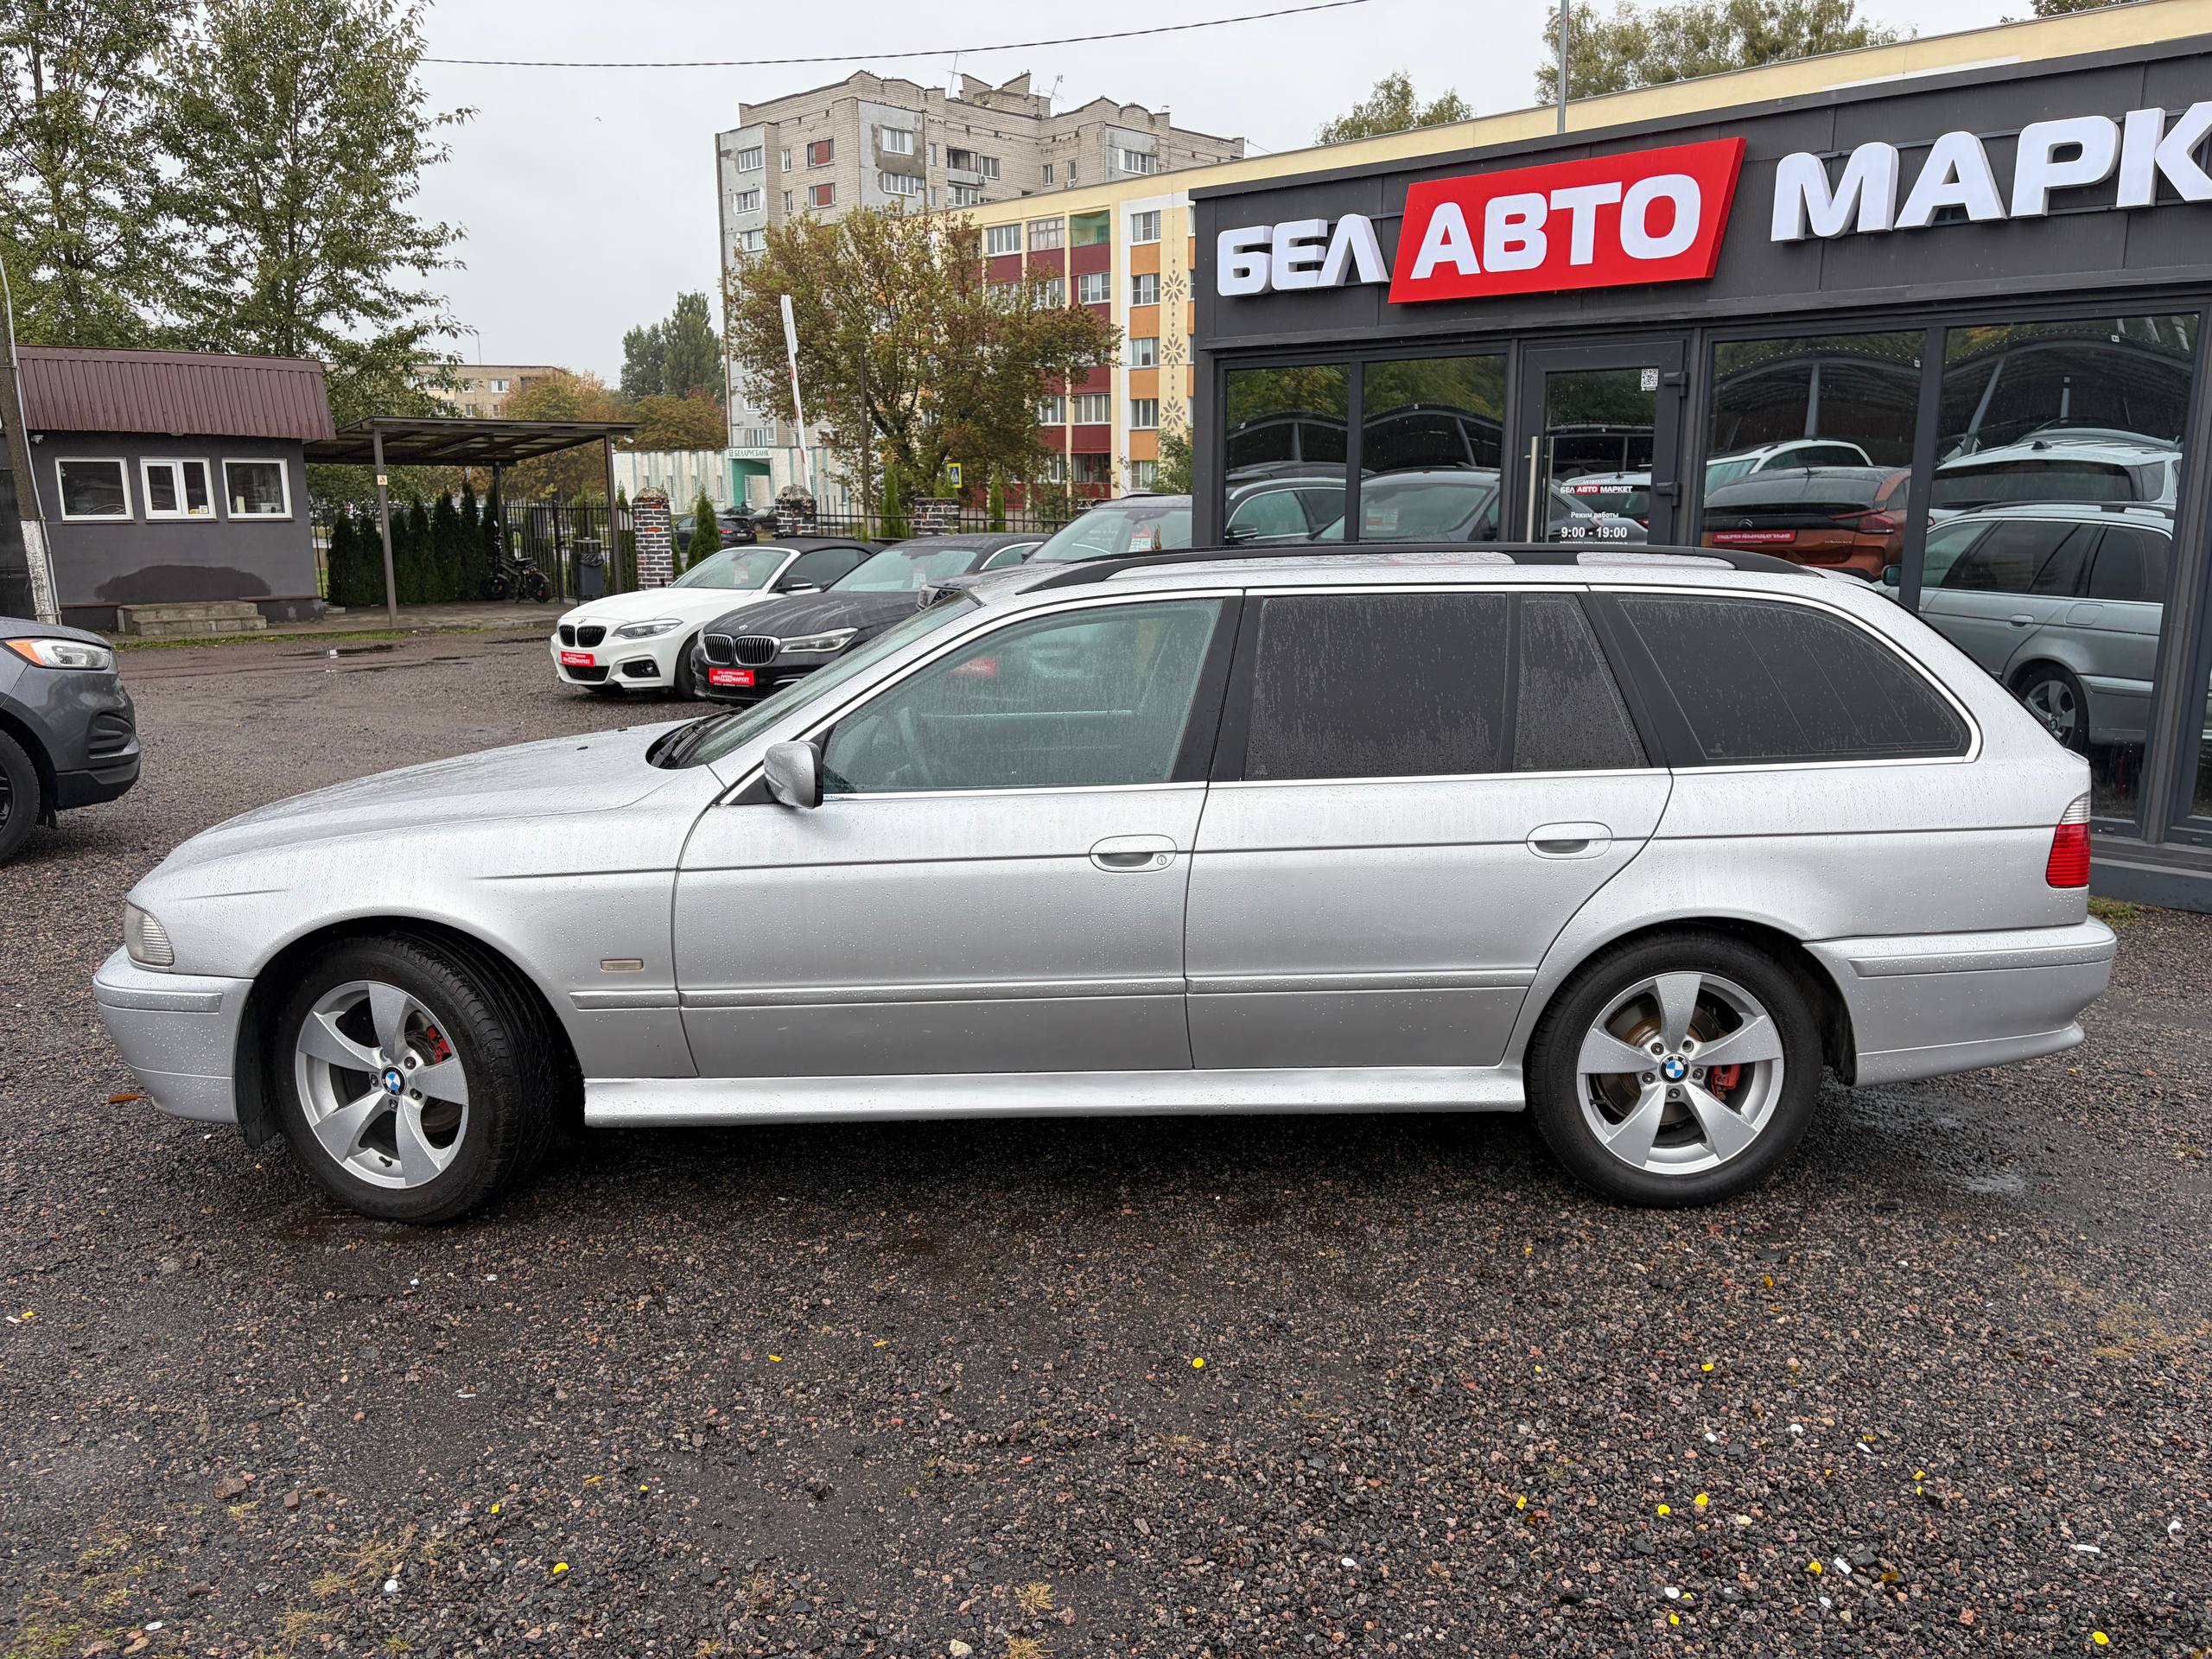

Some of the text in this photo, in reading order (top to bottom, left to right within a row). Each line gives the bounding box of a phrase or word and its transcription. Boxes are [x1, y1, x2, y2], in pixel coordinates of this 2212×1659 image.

[1217, 101, 2212, 296] БЕЛ АВТО МАРК
[1560, 526, 1586, 537] 9:00
[1596, 526, 1627, 537] 19:00
